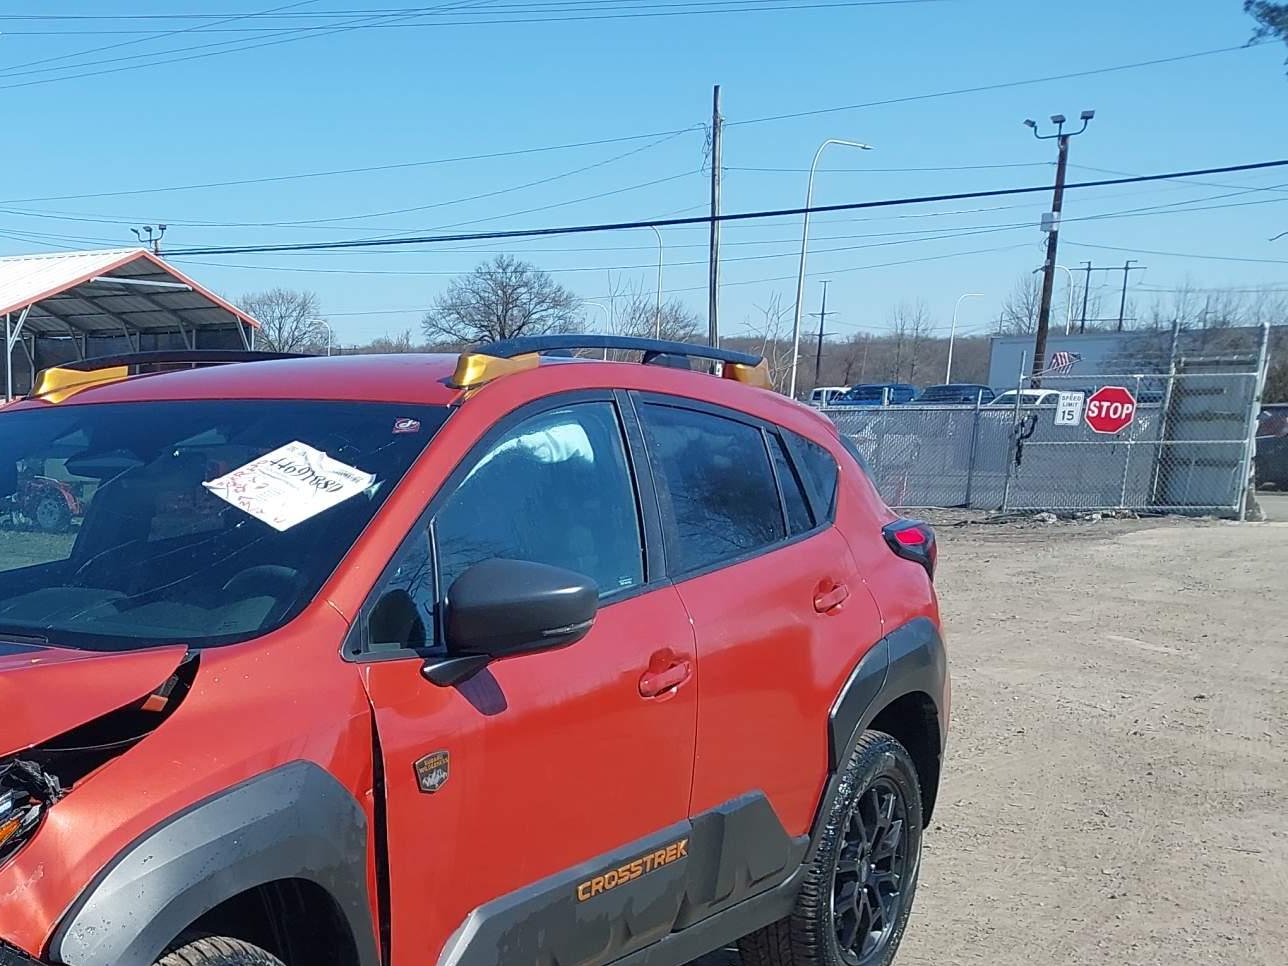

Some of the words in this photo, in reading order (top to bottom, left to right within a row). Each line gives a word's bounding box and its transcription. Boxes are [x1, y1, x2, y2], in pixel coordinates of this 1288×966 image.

[1062, 410, 1074, 421] 15
[1088, 401, 1132, 419] STOP
[576, 838, 689, 902] CROSSTREK
